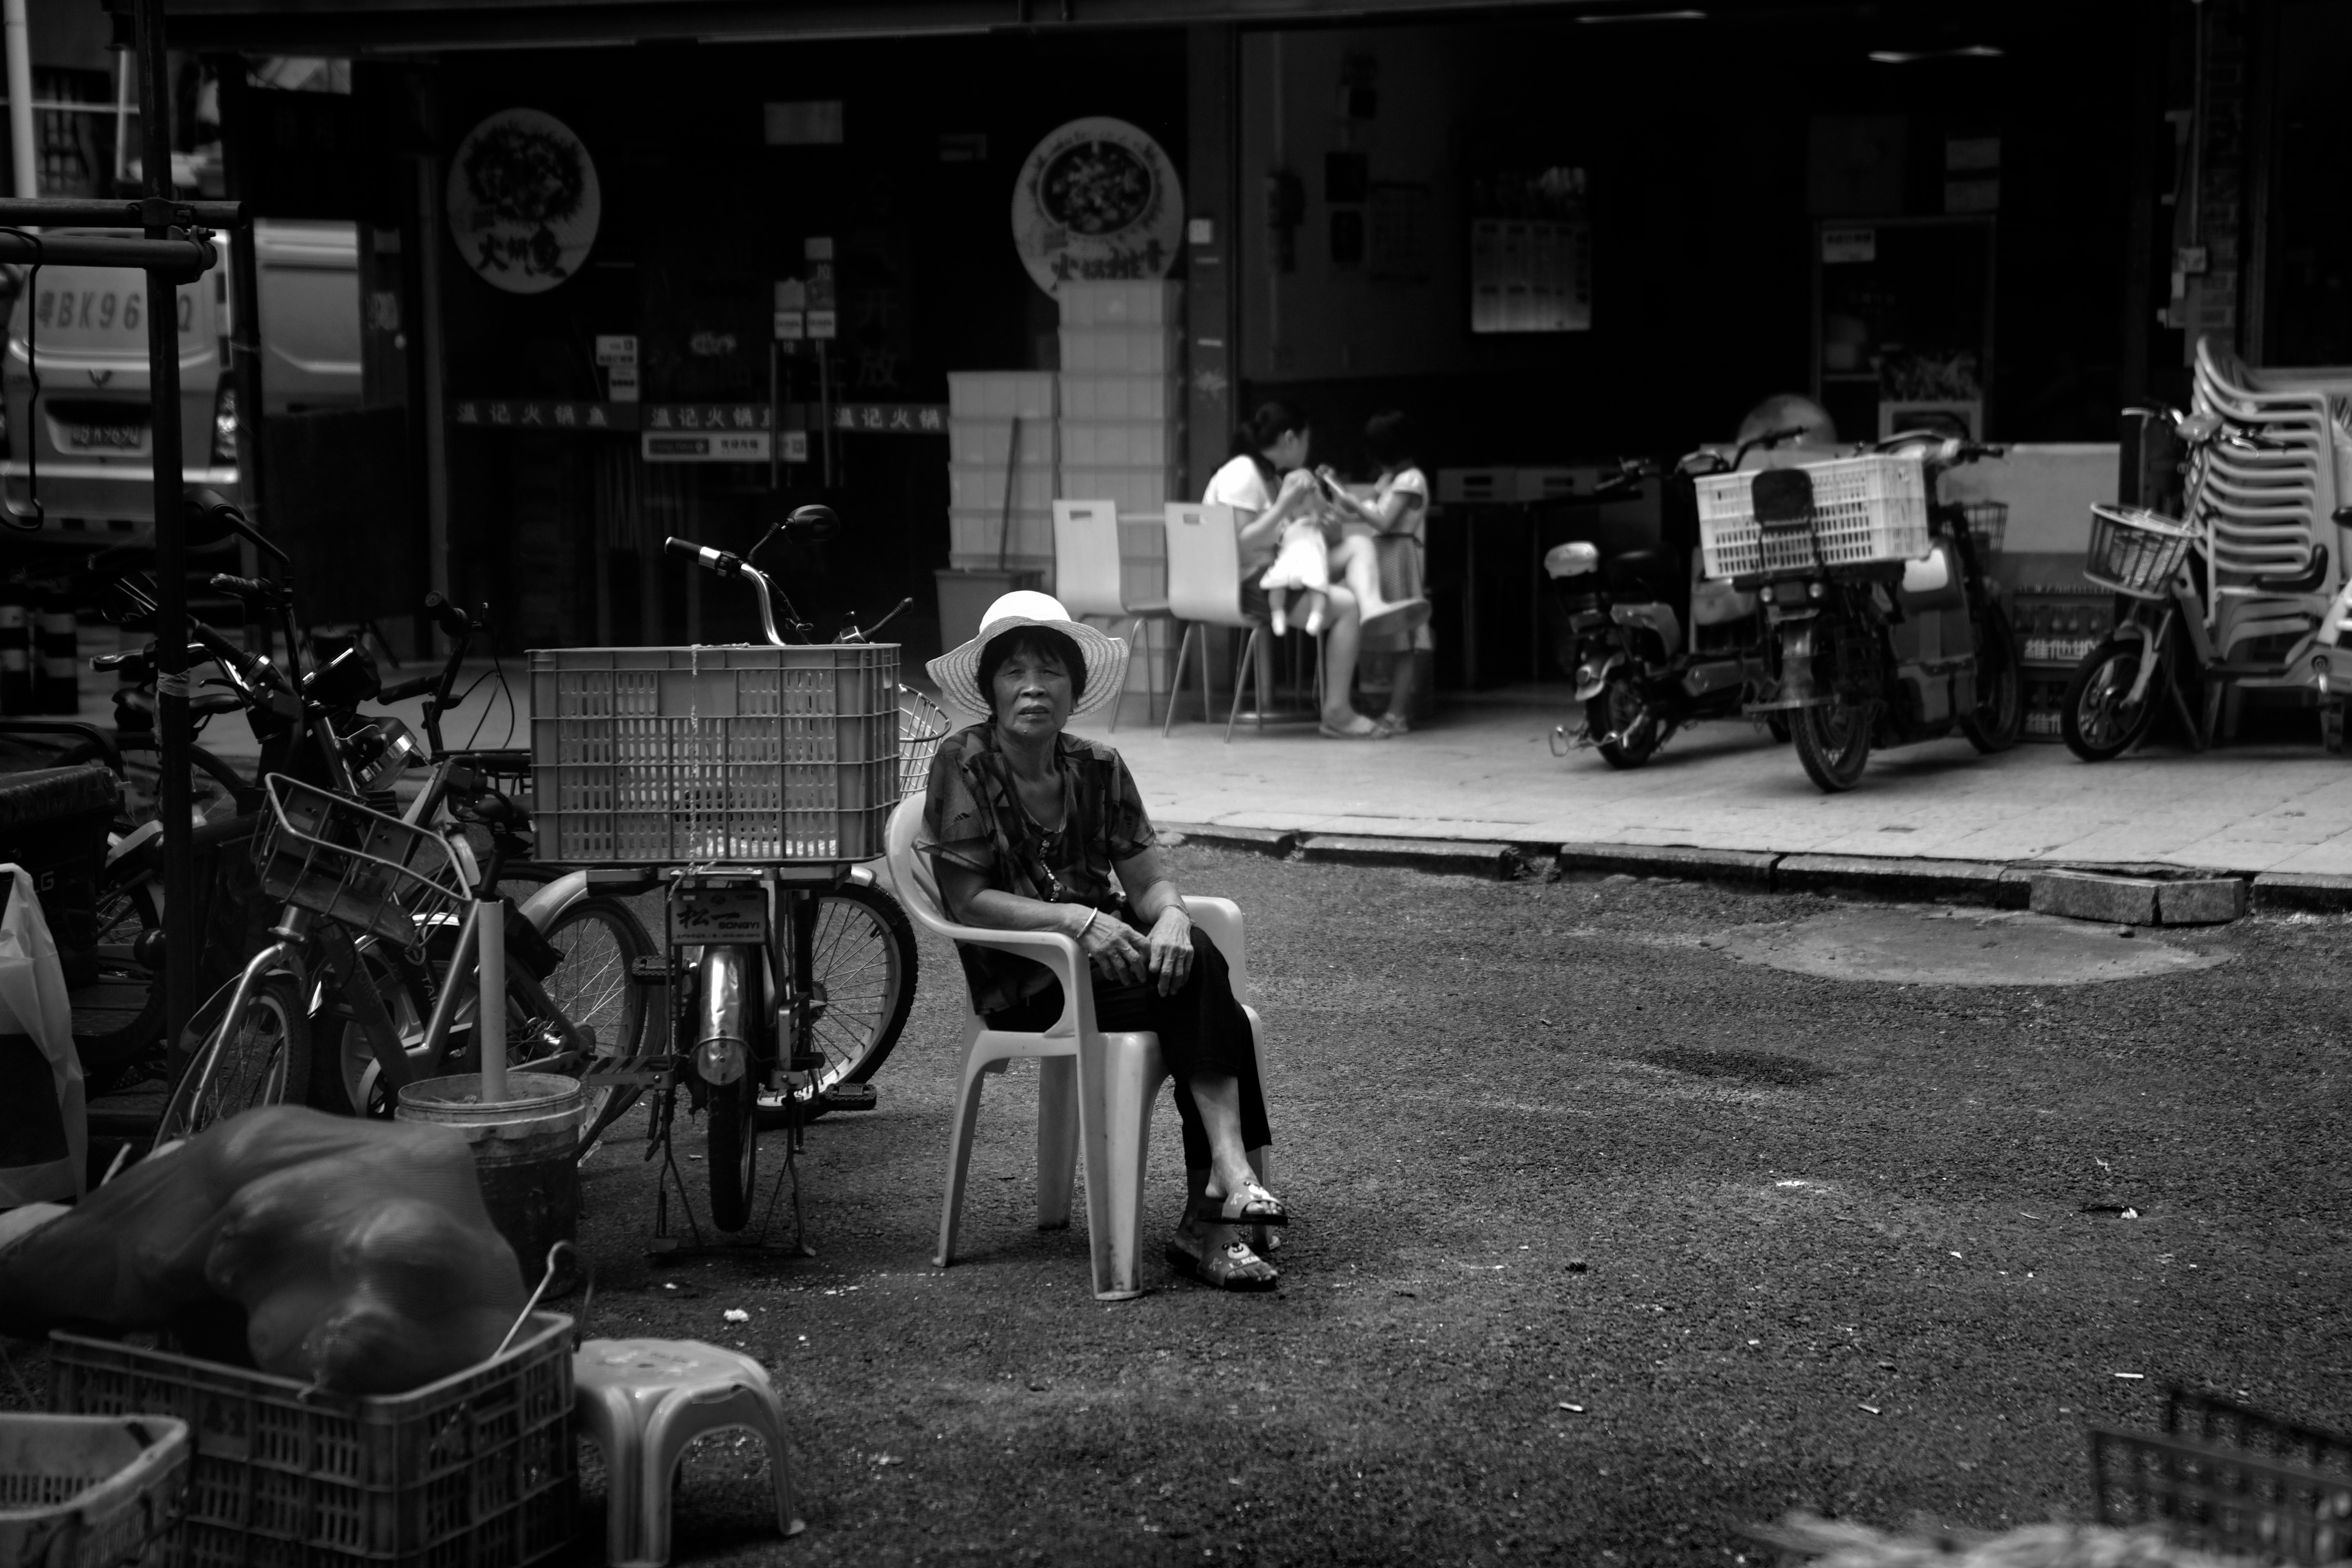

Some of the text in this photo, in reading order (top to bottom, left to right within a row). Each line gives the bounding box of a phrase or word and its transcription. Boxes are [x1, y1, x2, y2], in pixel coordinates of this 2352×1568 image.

[456, 403, 608, 427] 温记火锅鱼
